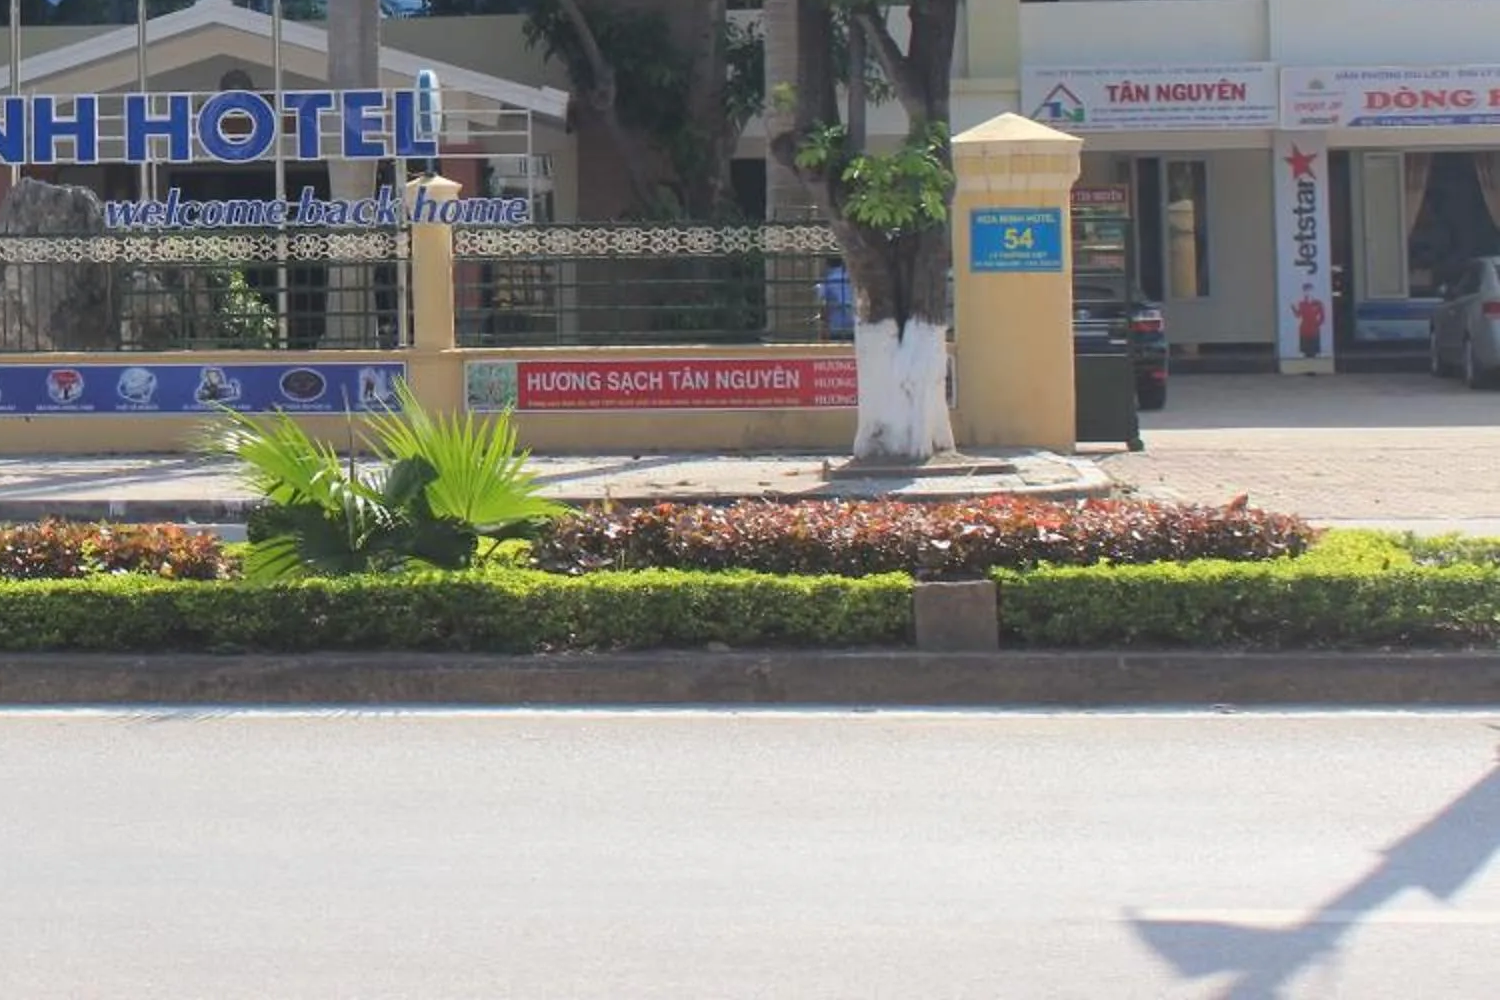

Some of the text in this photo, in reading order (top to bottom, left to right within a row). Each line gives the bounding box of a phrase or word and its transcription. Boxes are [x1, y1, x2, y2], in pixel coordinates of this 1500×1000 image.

[1105, 77, 1247, 103] TÂN NGUYÊN
[124, 89, 439, 162] HOTEL
[104, 185, 531, 229] welcome back home
[1003, 227, 1035, 249] 54
[1293, 179, 1318, 275] Jetstar
[527, 365, 800, 395] HƯƠNG SẠCH TÂN NGUYÊN
